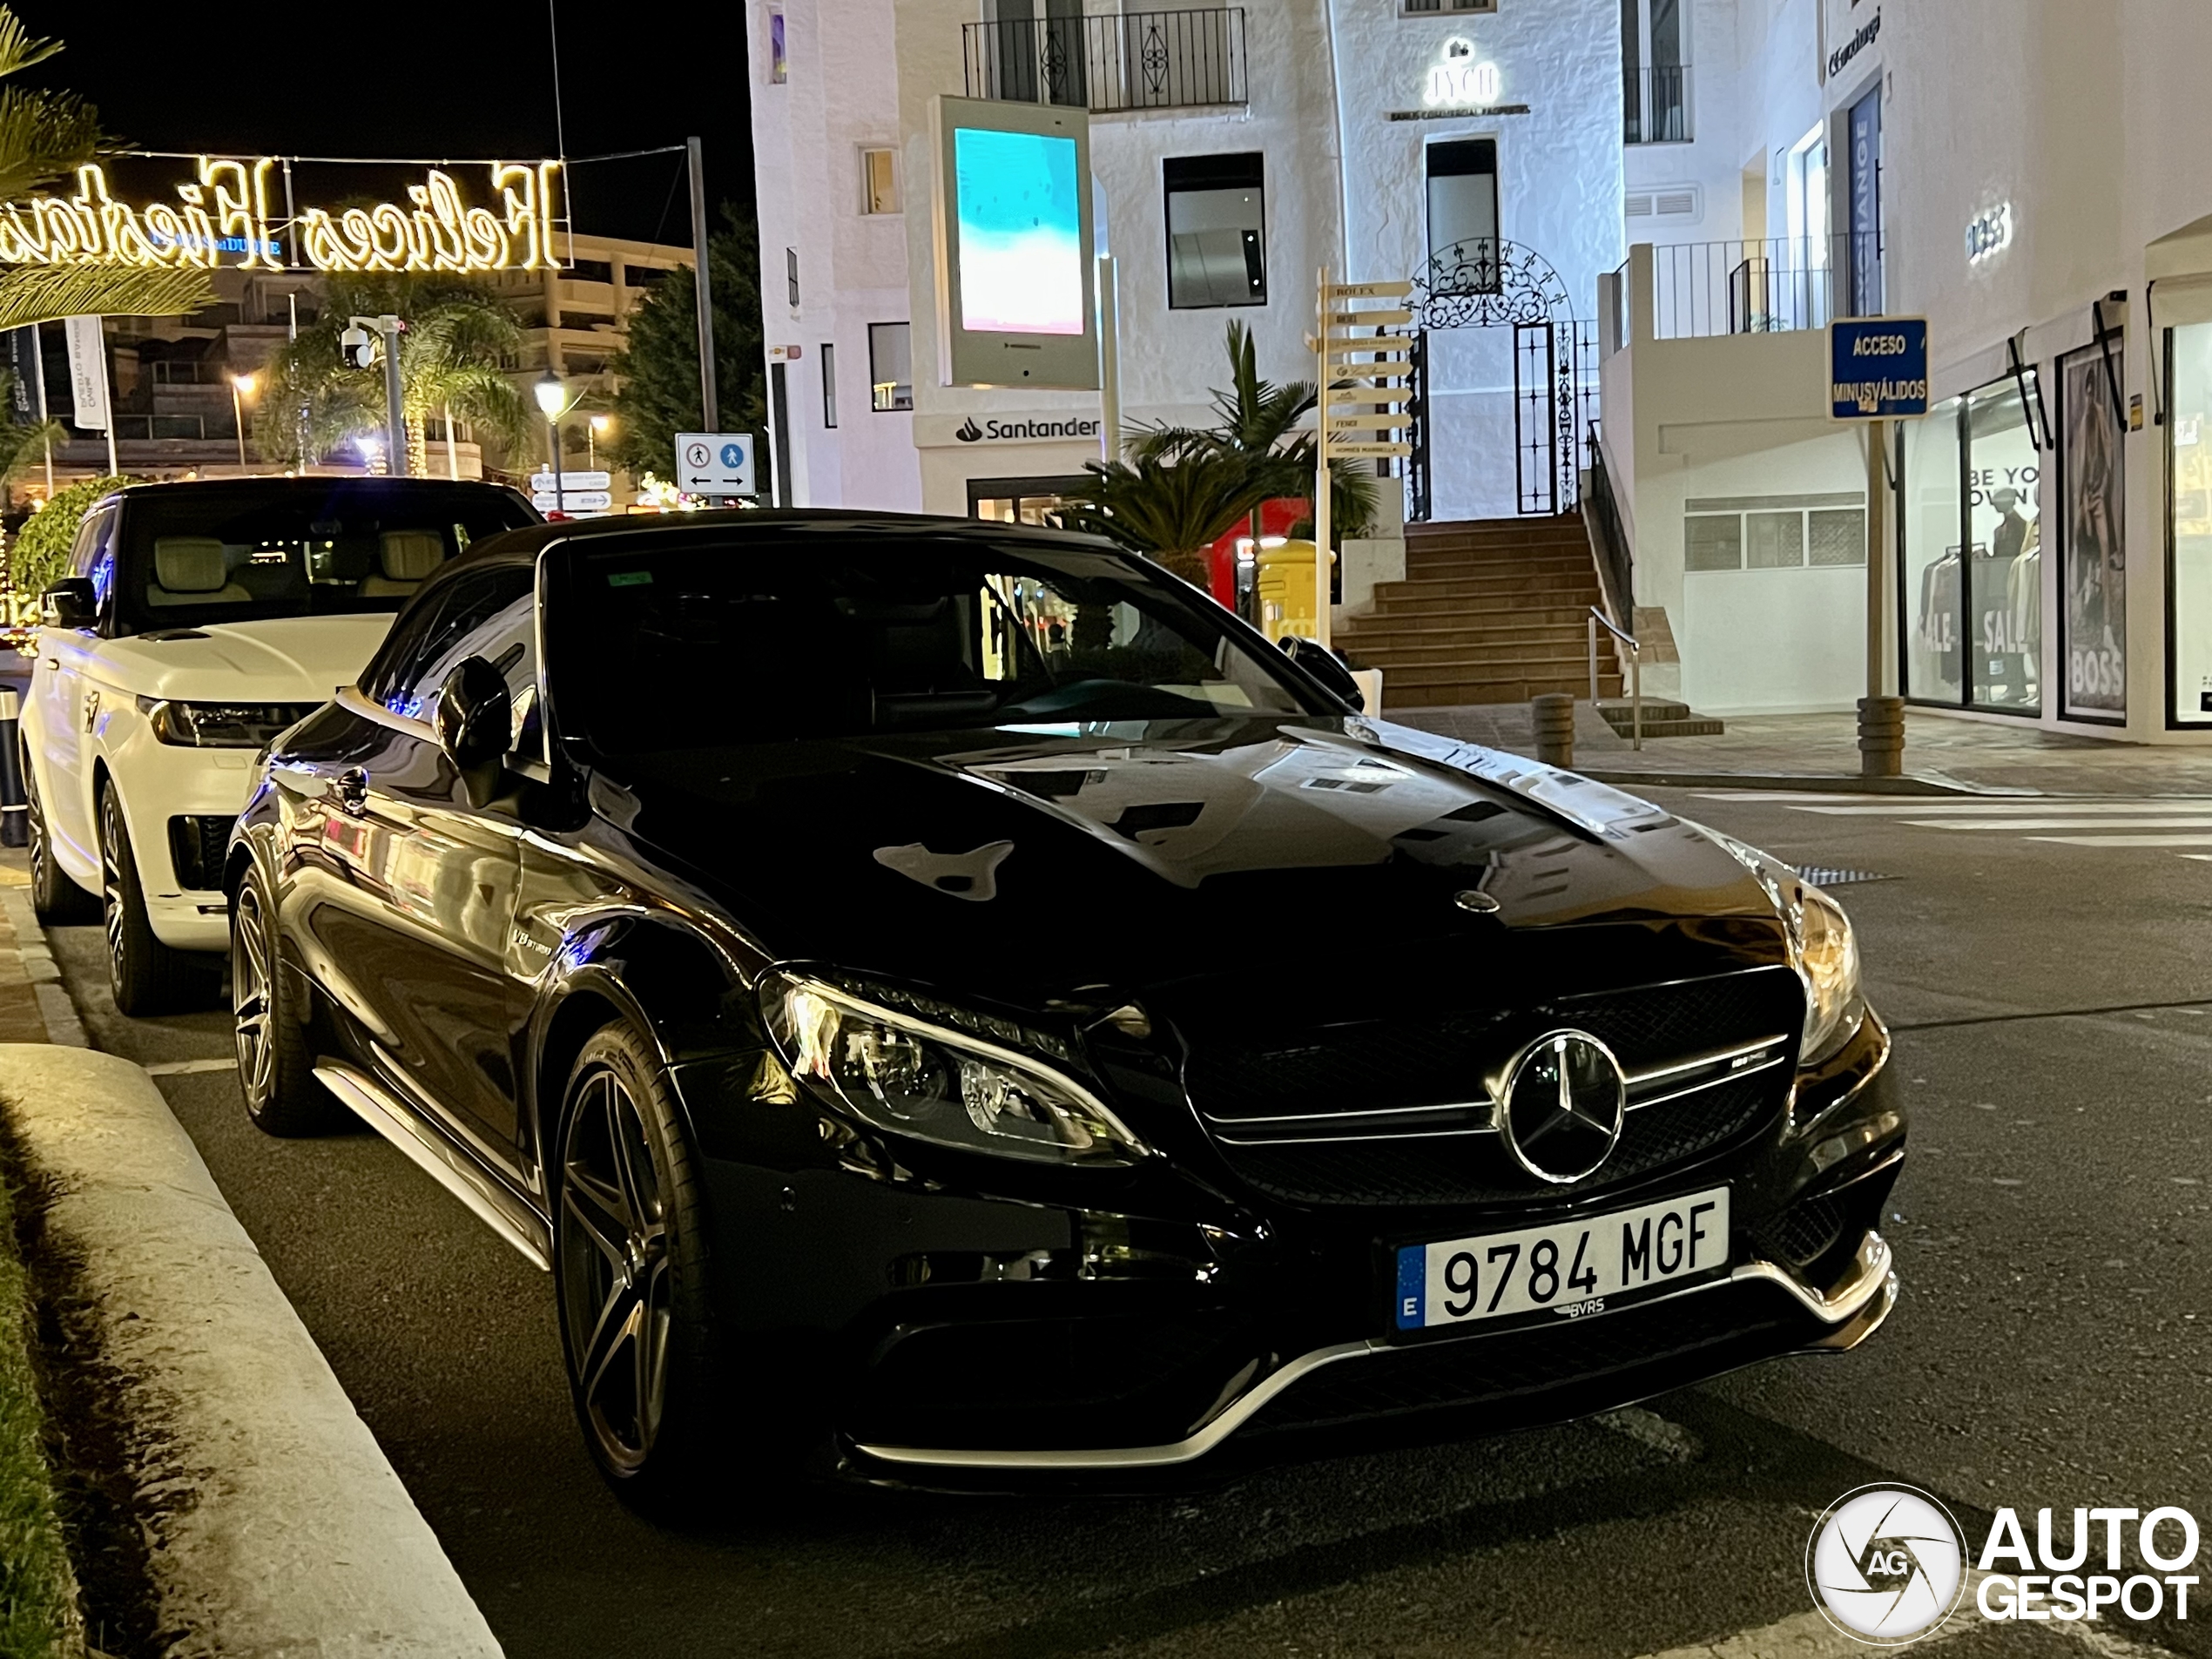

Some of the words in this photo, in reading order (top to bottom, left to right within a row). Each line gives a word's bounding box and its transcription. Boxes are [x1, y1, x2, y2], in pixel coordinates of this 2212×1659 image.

[1336, 287, 1375, 296] ROLEX
[1853, 334, 1906, 356] ACCESO
[1833, 376, 1925, 402] MINUSVÁLIDOS
[987, 418, 1101, 440] Santander
[1970, 469, 1994, 486] BE
[2072, 650, 2123, 696] BOSS
[1403, 1298, 1417, 1316] E
[1443, 1231, 1597, 1317] 9784
[1621, 1201, 1716, 1286] MGF
